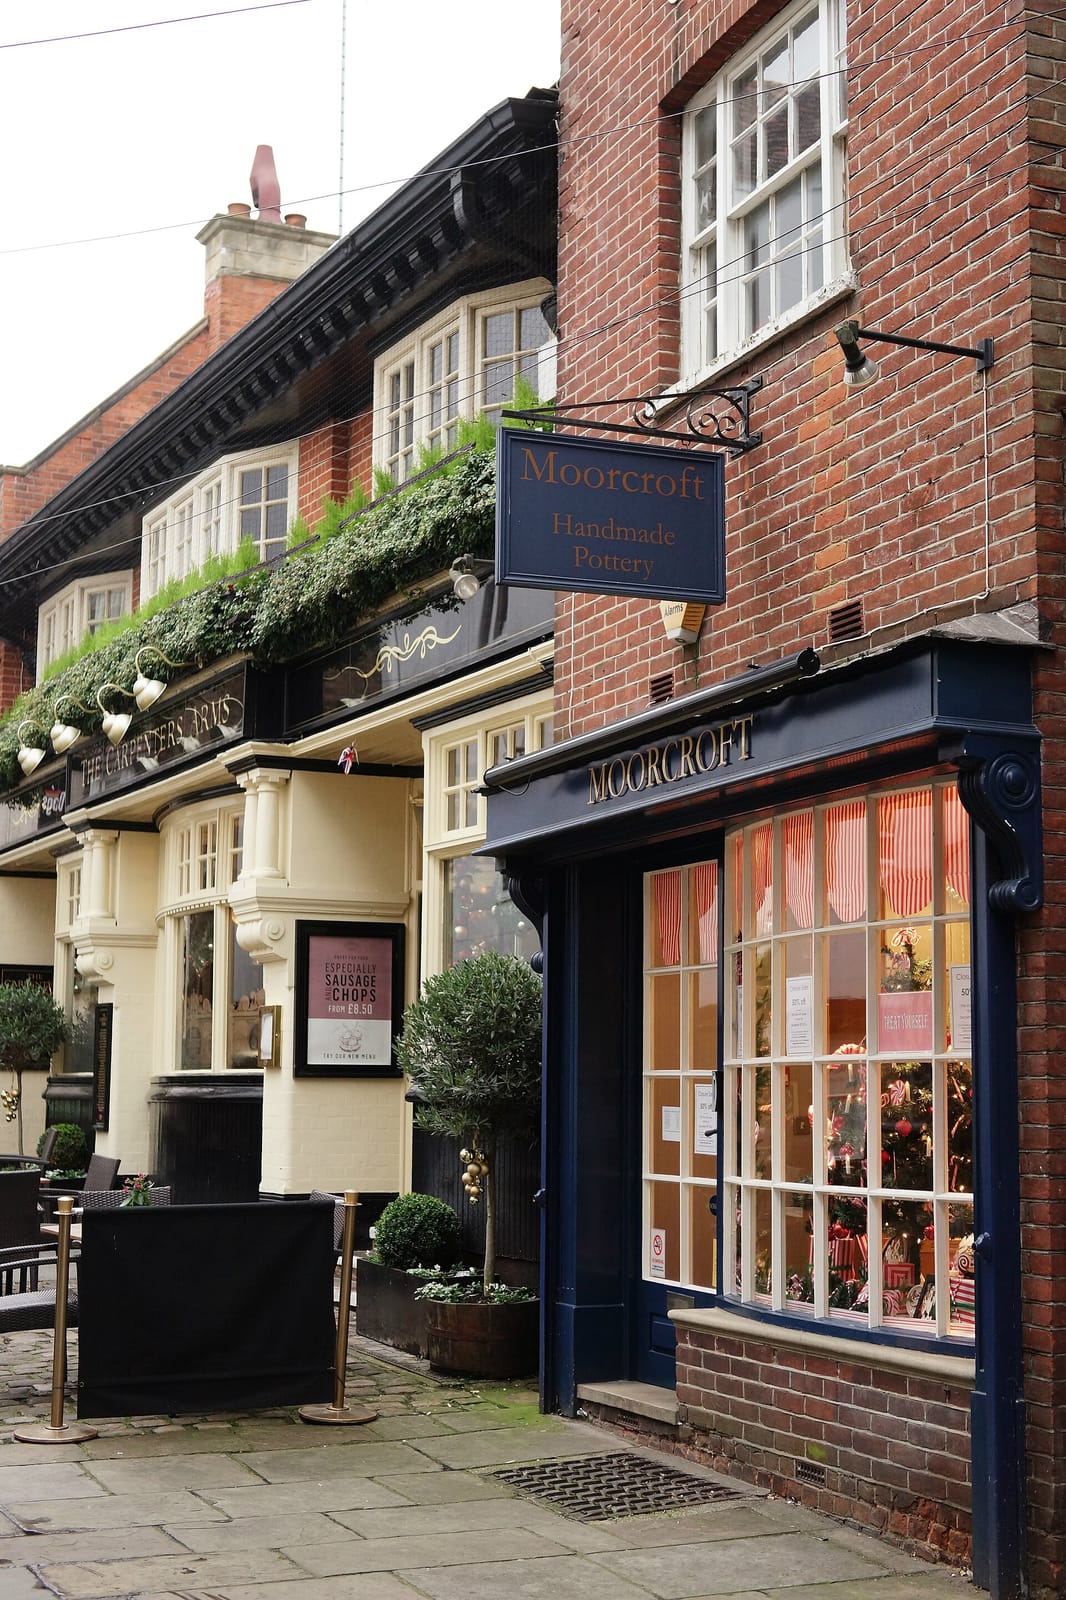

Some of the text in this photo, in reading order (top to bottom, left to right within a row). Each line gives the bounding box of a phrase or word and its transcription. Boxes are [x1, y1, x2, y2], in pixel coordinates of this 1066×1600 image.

[520, 448, 705, 500] Moorcroft
[552, 512, 676, 546] Handmade
[573, 546, 656, 581] Pottery
[81, 693, 231, 787] THE CARPENTERS ARMS
[587, 714, 754, 805] MOORCROFT
[325, 962, 376, 974] ESPECIALLY
[325, 974, 376, 988] SAUSAGE
[332, 987, 376, 1003] CHOPS
[328, 1003, 373, 1015] FROM £8.50
[883, 1013, 928, 1030] TREAT YOURSELF
